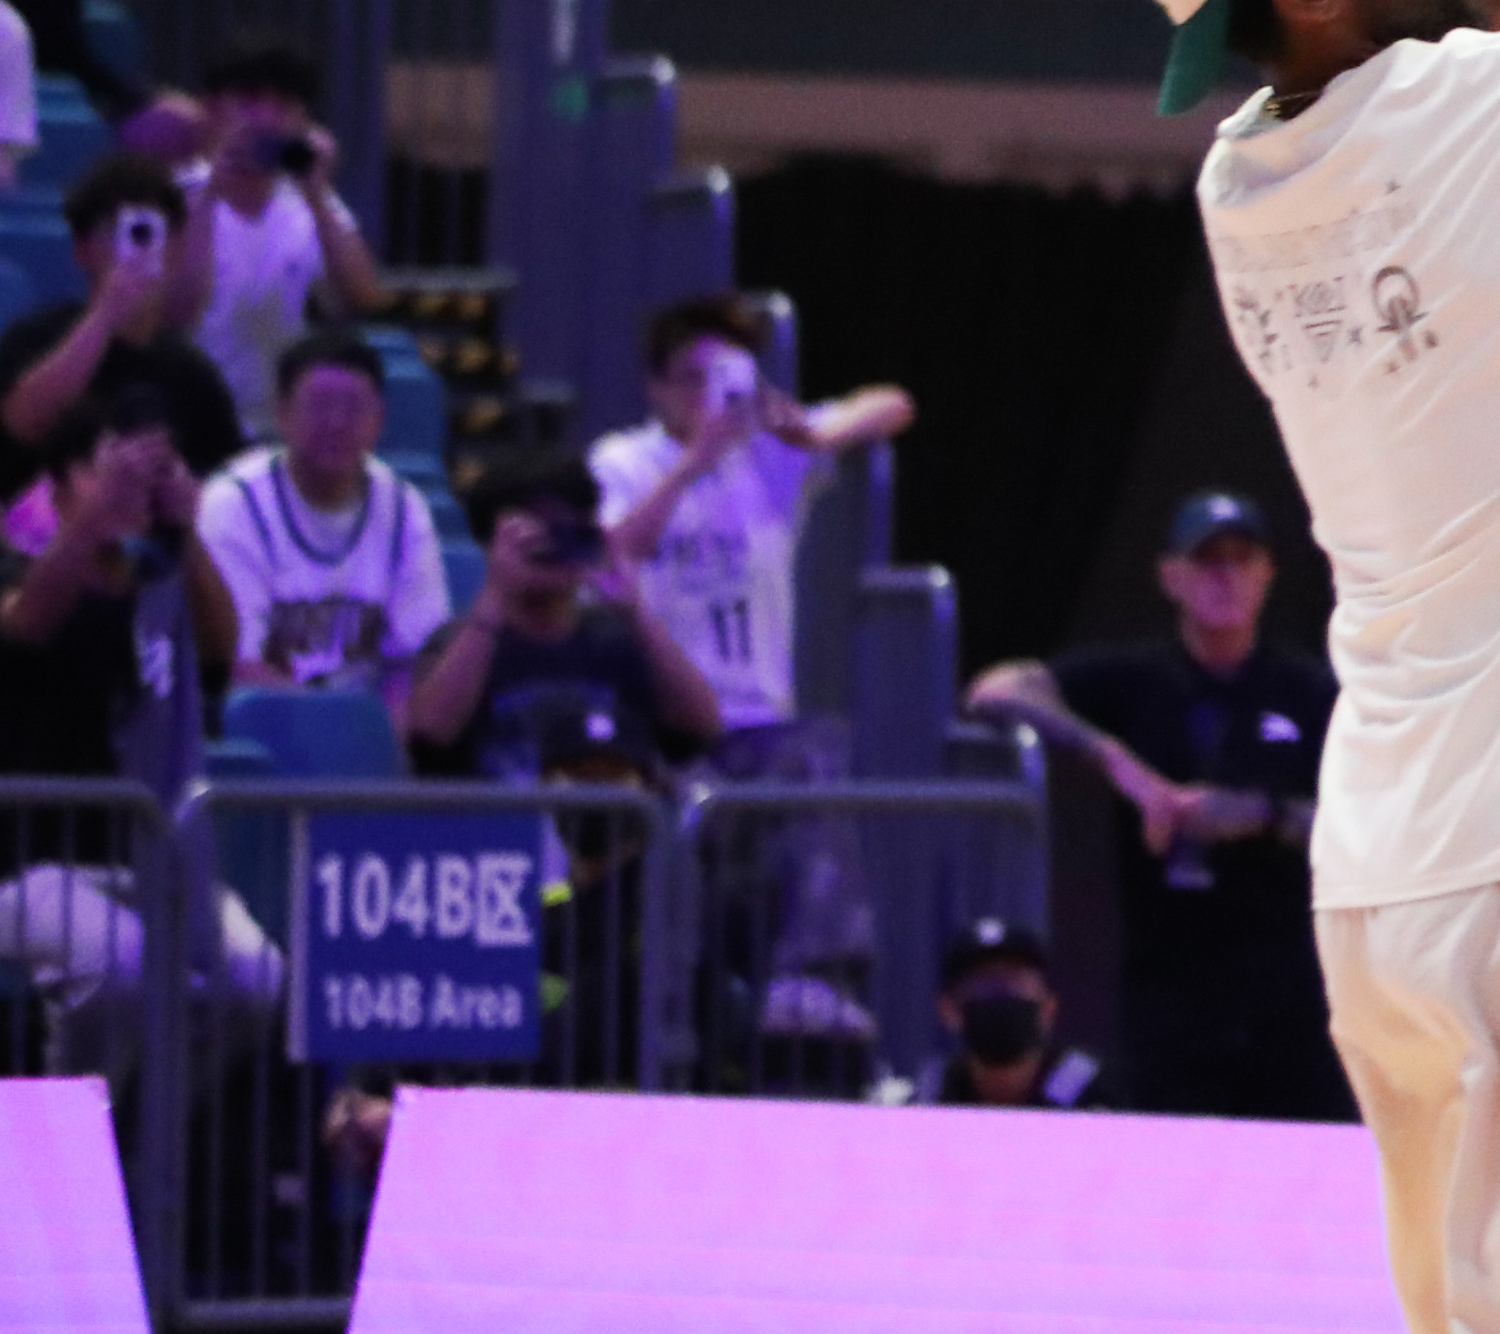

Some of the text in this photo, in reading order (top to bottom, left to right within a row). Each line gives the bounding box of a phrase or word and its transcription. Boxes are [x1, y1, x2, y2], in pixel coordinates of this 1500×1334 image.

[316, 851, 534, 948] 104B区
[324, 973, 524, 1031] 104B Area
